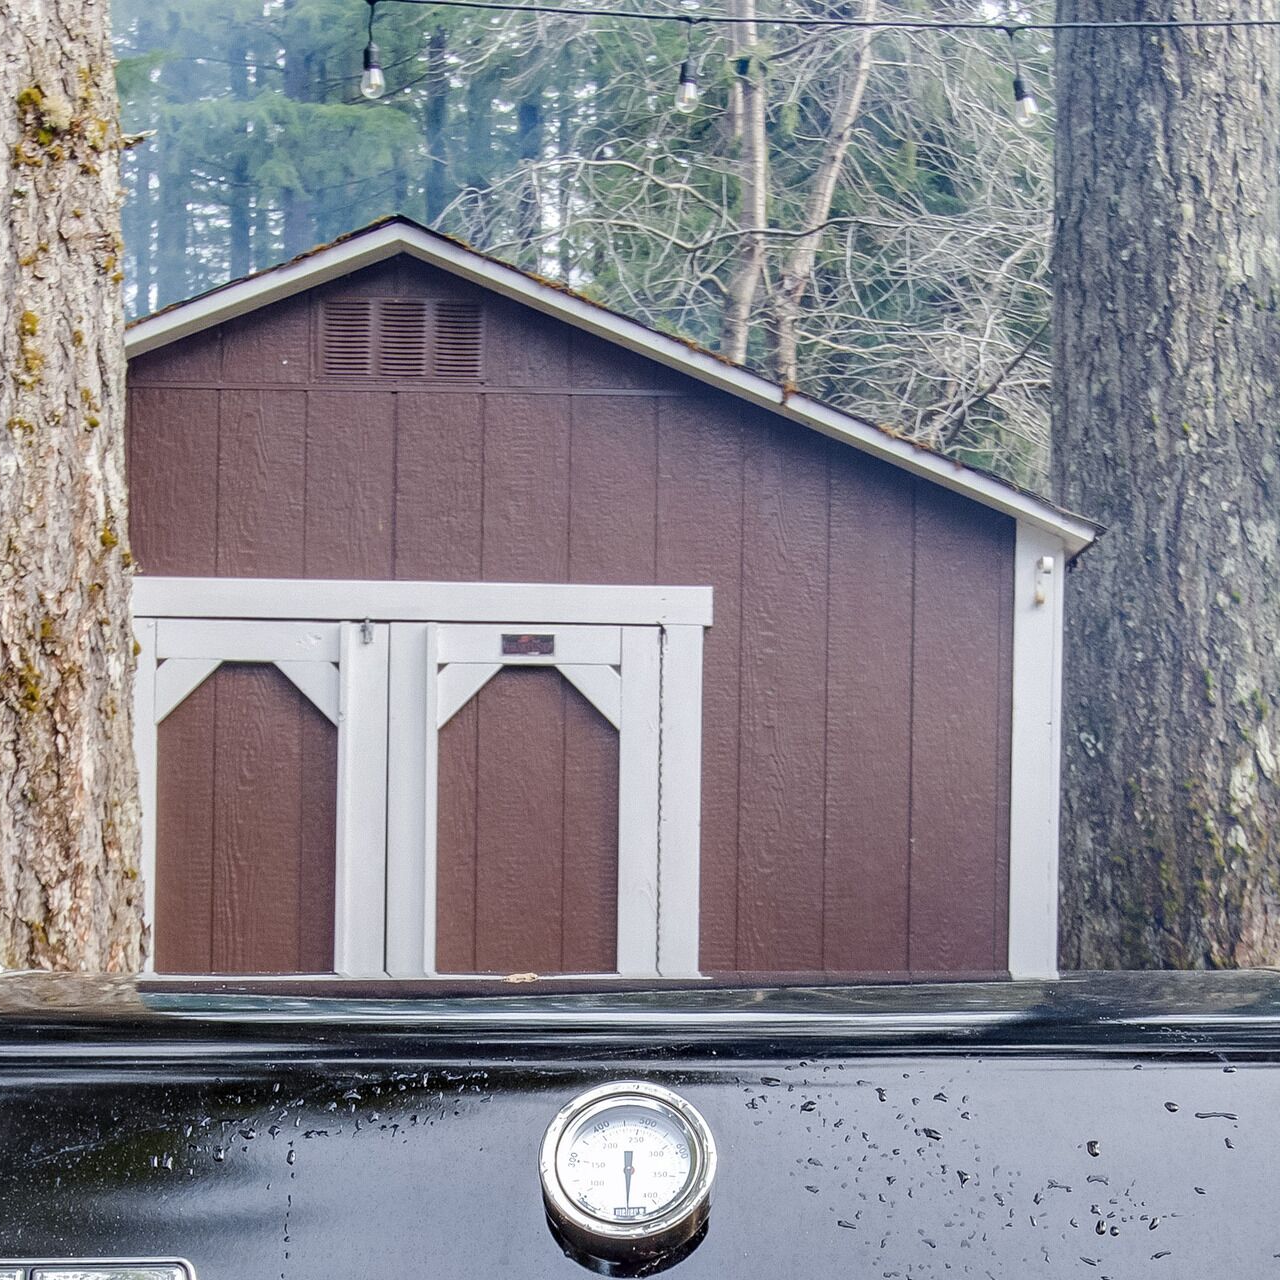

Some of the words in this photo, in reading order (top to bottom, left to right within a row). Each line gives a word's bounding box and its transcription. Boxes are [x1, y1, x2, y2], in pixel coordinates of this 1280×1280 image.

[593, 1120, 610, 1133] 400
[639, 1118, 657, 1128] 500
[628, 1136, 644, 1144] 250
[676, 1143, 688, 1159] 600
[568, 1152, 578, 1167] 300
[591, 1161, 606, 1169] 150
[643, 1191, 658, 1199] 400
